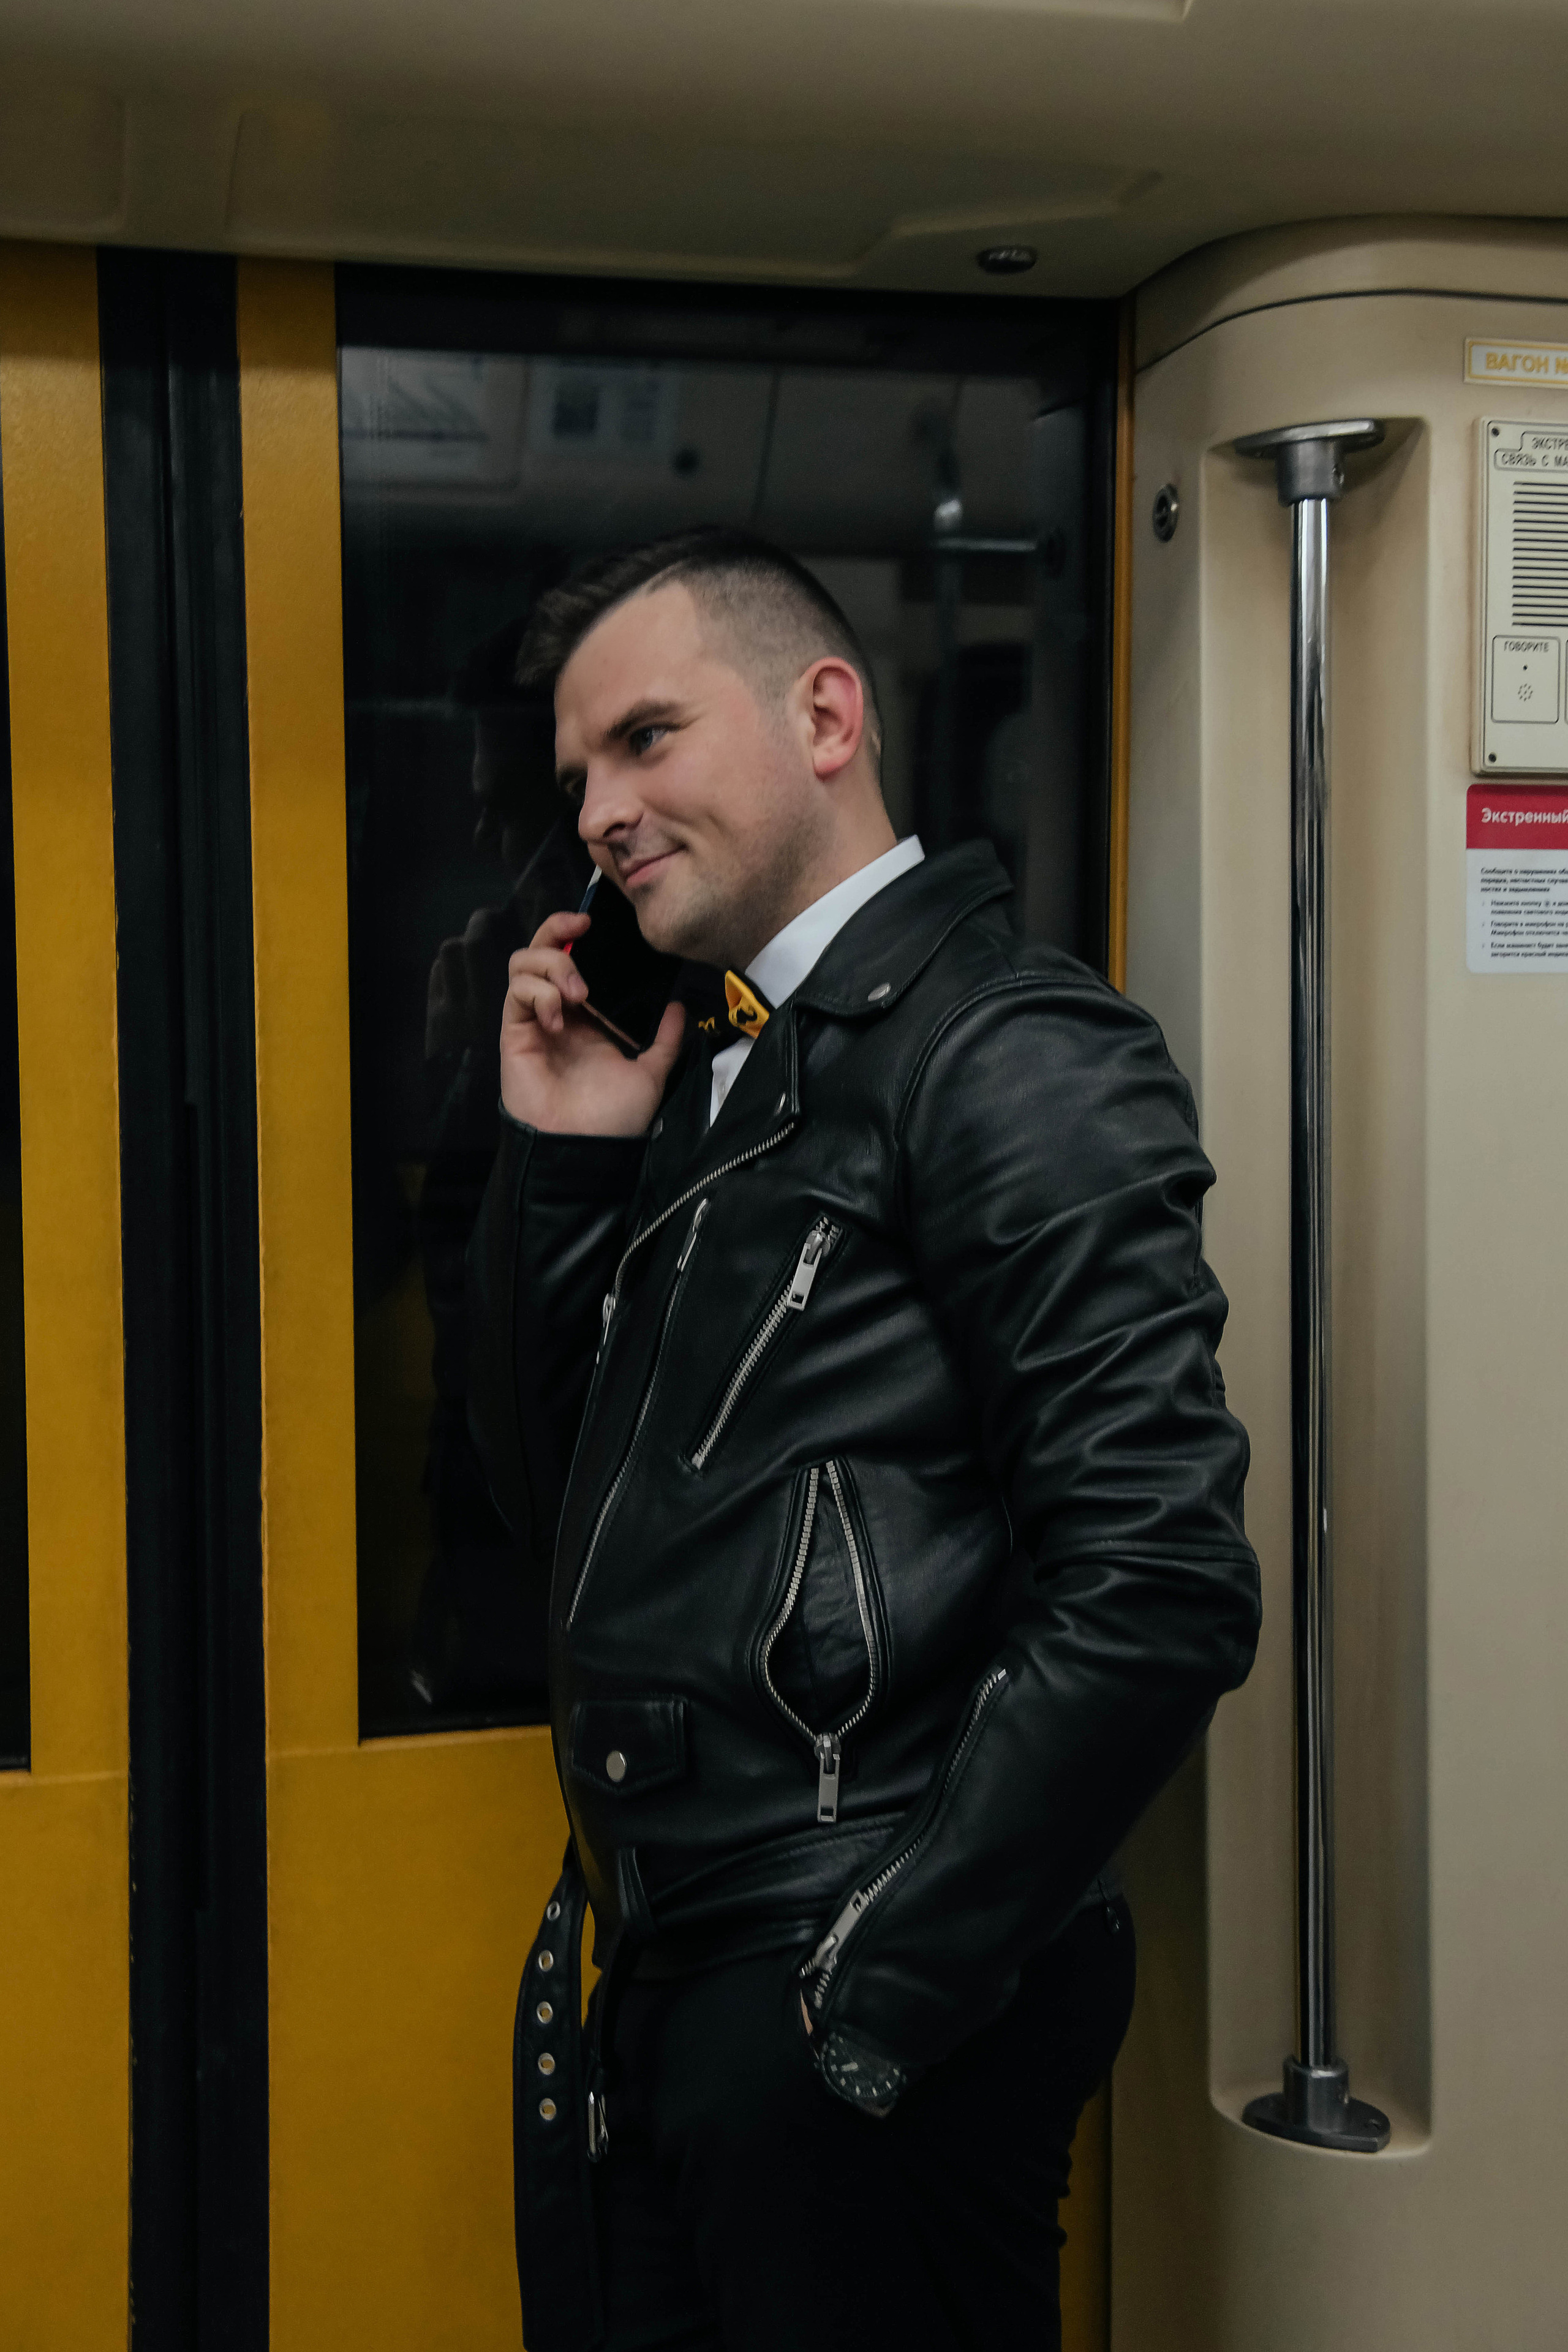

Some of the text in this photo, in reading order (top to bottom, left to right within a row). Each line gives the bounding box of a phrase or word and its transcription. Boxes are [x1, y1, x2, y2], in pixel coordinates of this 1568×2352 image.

[1486, 352, 1549, 373] ВАГОН
[1502, 453, 1536, 466] СВЯЗЬ
[1542, 454, 1548, 467] С
[1504, 641, 1549, 653] ГОВОРИТЕ
[1481, 807, 1568, 826] Экстренный
